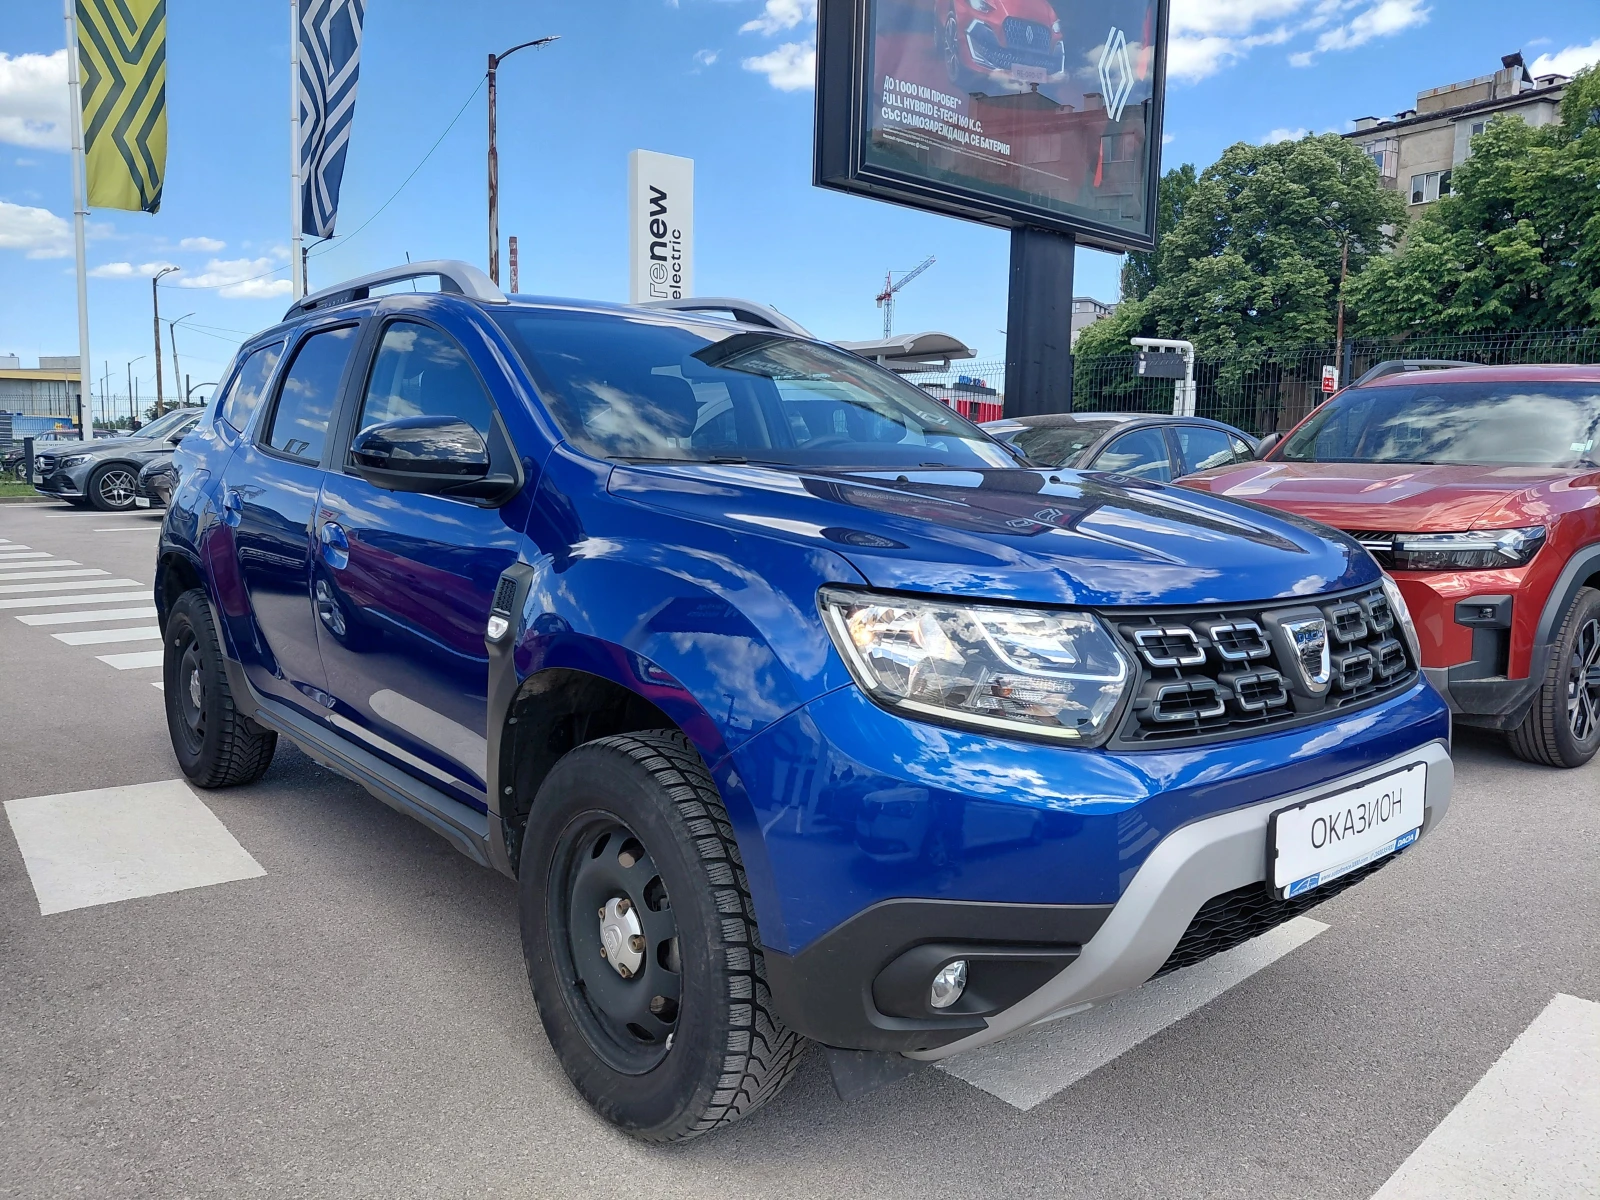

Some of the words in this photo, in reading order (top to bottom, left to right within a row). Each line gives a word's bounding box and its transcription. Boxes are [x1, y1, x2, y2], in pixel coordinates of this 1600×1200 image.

[882, 91, 903, 108] FULL
[904, 97, 933, 115] HYBRID
[934, 105, 959, 125] E-TECH
[883, 75, 894, 91] ДО
[918, 86, 930, 100] КМ
[881, 107, 901, 122] СЪС
[901, 111, 970, 145] САМОЗАРЕЖДАЩА
[970, 135, 980, 147] СЕ
[980, 136, 1011, 156] БАТЕРИЯ
[649, 185, 668, 298] renew
[669, 228, 682, 300] electric
[1311, 788, 1402, 848] ОКАЗИОН
[1397, 833, 1414, 847] DACIA
